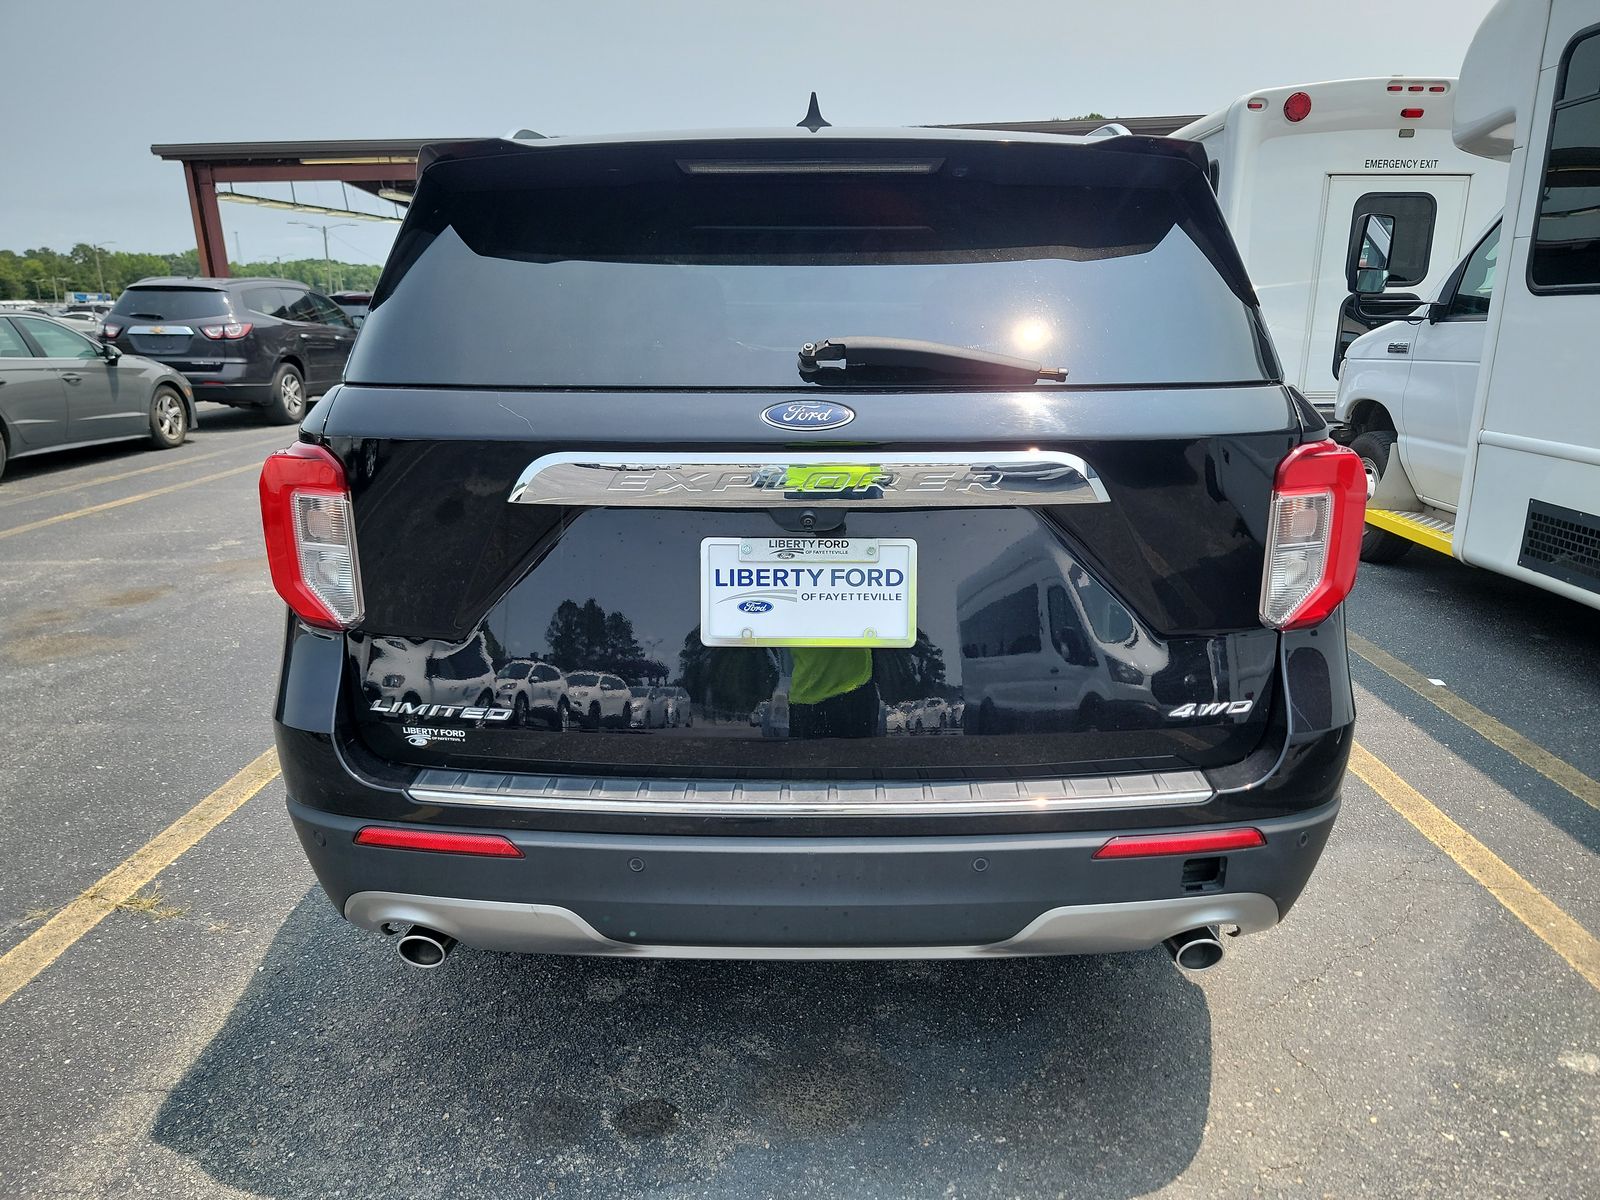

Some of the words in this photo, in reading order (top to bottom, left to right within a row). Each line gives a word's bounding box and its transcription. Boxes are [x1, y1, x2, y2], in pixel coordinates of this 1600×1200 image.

[1364, 159, 1418, 169] EMERGENCY
[1420, 159, 1439, 169] EXIT
[783, 404, 832, 421] Ford
[606, 471, 1005, 493] EXPLORER
[768, 539, 816, 548] LIBERTY
[818, 539, 849, 549] FORD
[715, 568, 825, 587] LIBERTY
[830, 568, 904, 587] FORD
[801, 592, 817, 601] OF
[819, 592, 902, 602] FAYETTEVILLE
[743, 601, 767, 612] Ford
[370, 699, 514, 720] LIMITED
[1168, 700, 1253, 717] 4WD
[402, 727, 439, 736] LIBERTY
[440, 729, 466, 737] FORD
